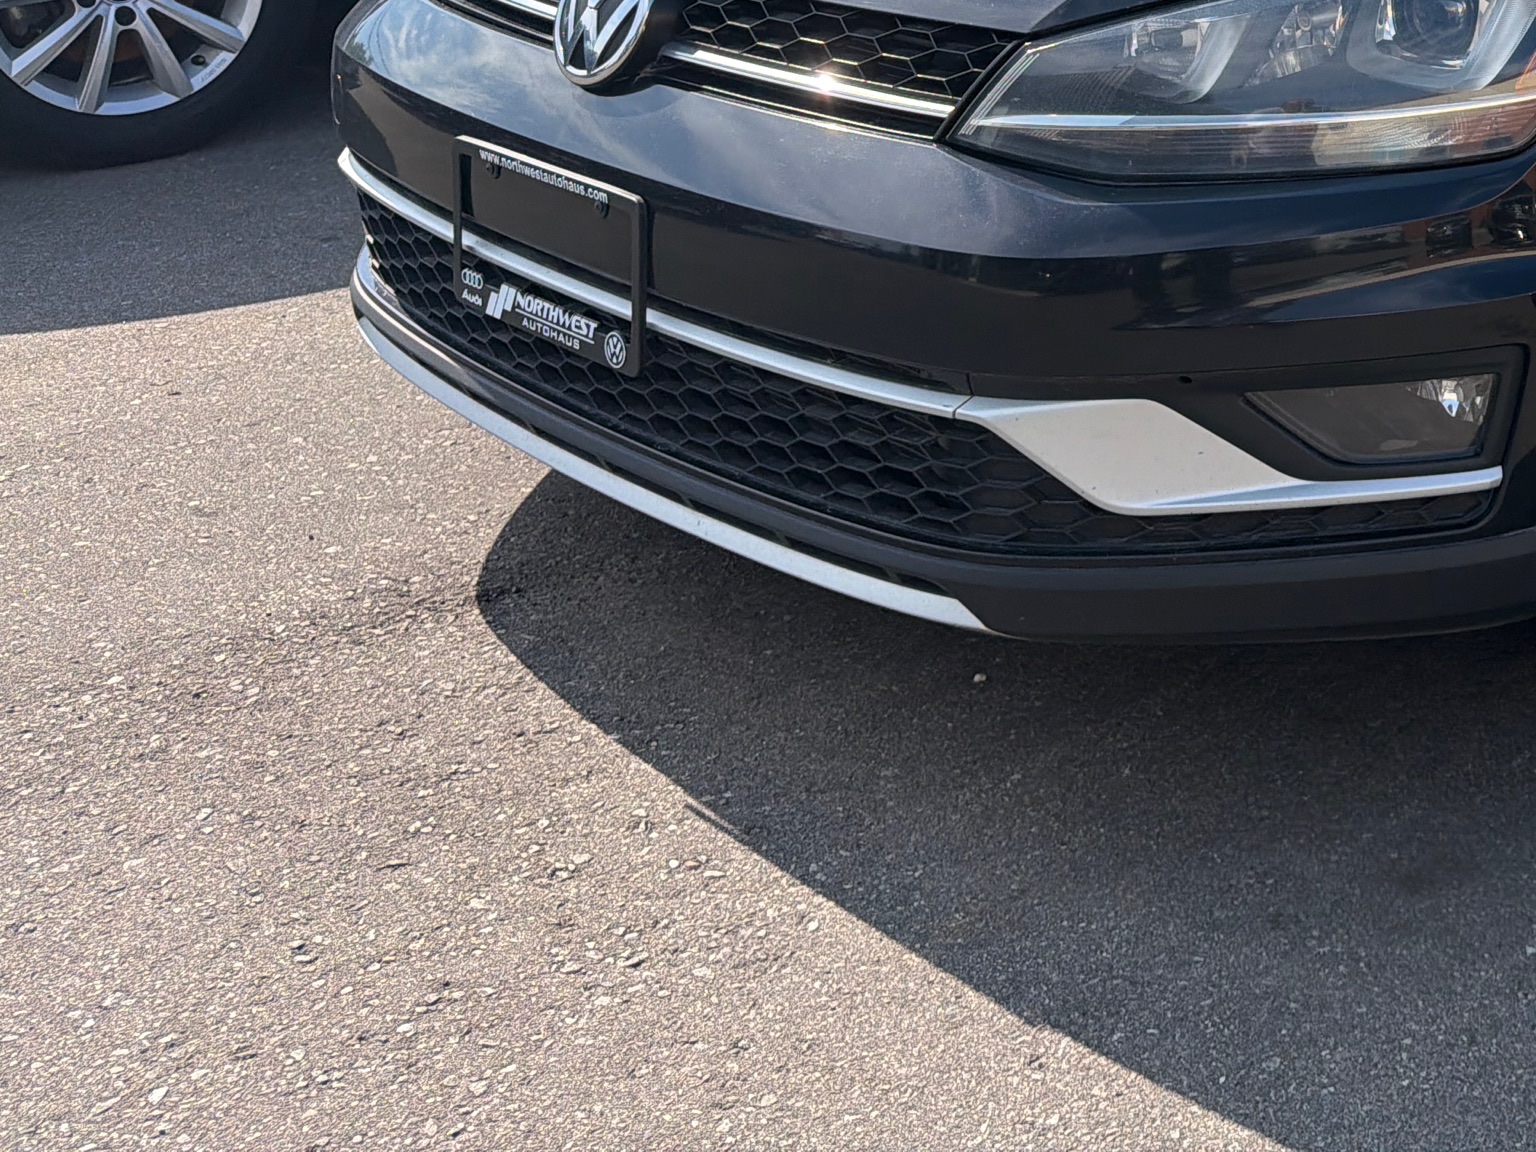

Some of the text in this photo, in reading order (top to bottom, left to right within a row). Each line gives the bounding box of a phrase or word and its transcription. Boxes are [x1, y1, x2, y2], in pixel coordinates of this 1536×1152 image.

[479, 149, 608, 204] www.northwestautohaus.com
[461, 288, 483, 307] Audi
[515, 291, 598, 339] NORTHWEST
[522, 317, 580, 350] AUTOHAUS
